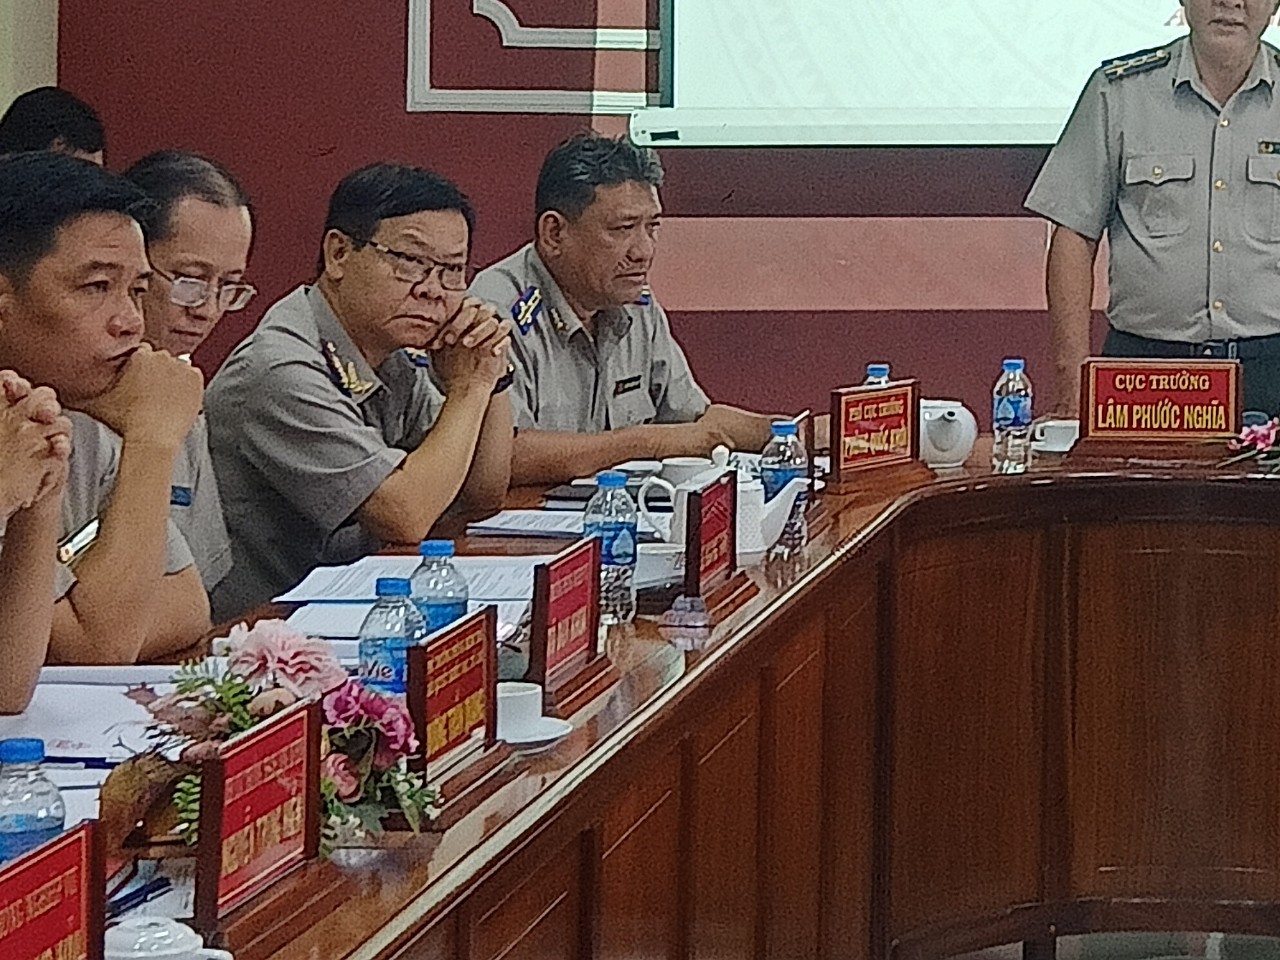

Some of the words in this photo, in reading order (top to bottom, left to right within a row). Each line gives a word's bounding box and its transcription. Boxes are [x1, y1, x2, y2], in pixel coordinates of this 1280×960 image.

[1115, 374, 1147, 392] CỤC
[1149, 370, 1210, 390] TRƯỞNG
[1098, 398, 1129, 429] LÂM
[1132, 398, 1180, 429] PHƯỚC
[1183, 399, 1226, 429] NGHĨA
